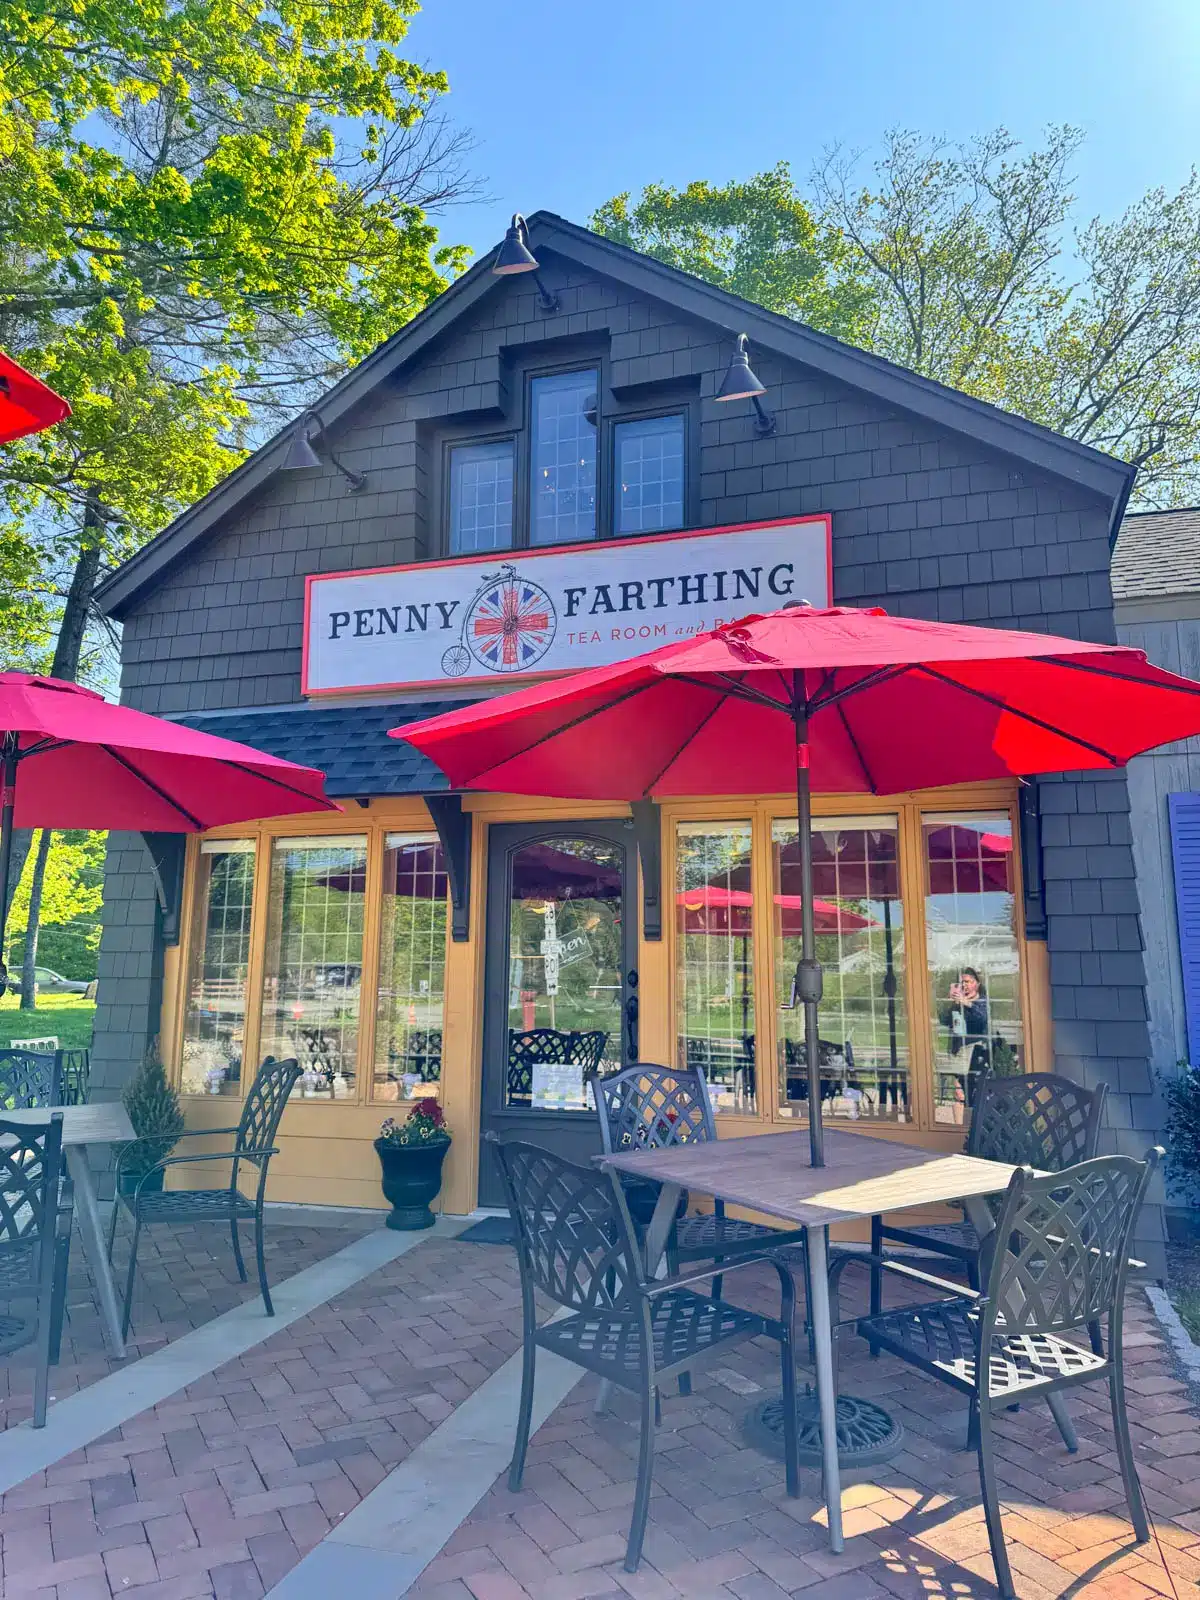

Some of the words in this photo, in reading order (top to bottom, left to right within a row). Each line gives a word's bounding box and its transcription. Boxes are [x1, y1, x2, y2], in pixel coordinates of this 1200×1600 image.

[328, 600, 460, 639] PENNY
[563, 563, 794, 617] FARTHING
[567, 630, 602, 645] TEA
[611, 624, 667, 641] ROOM
[675, 619, 705, 636] and
